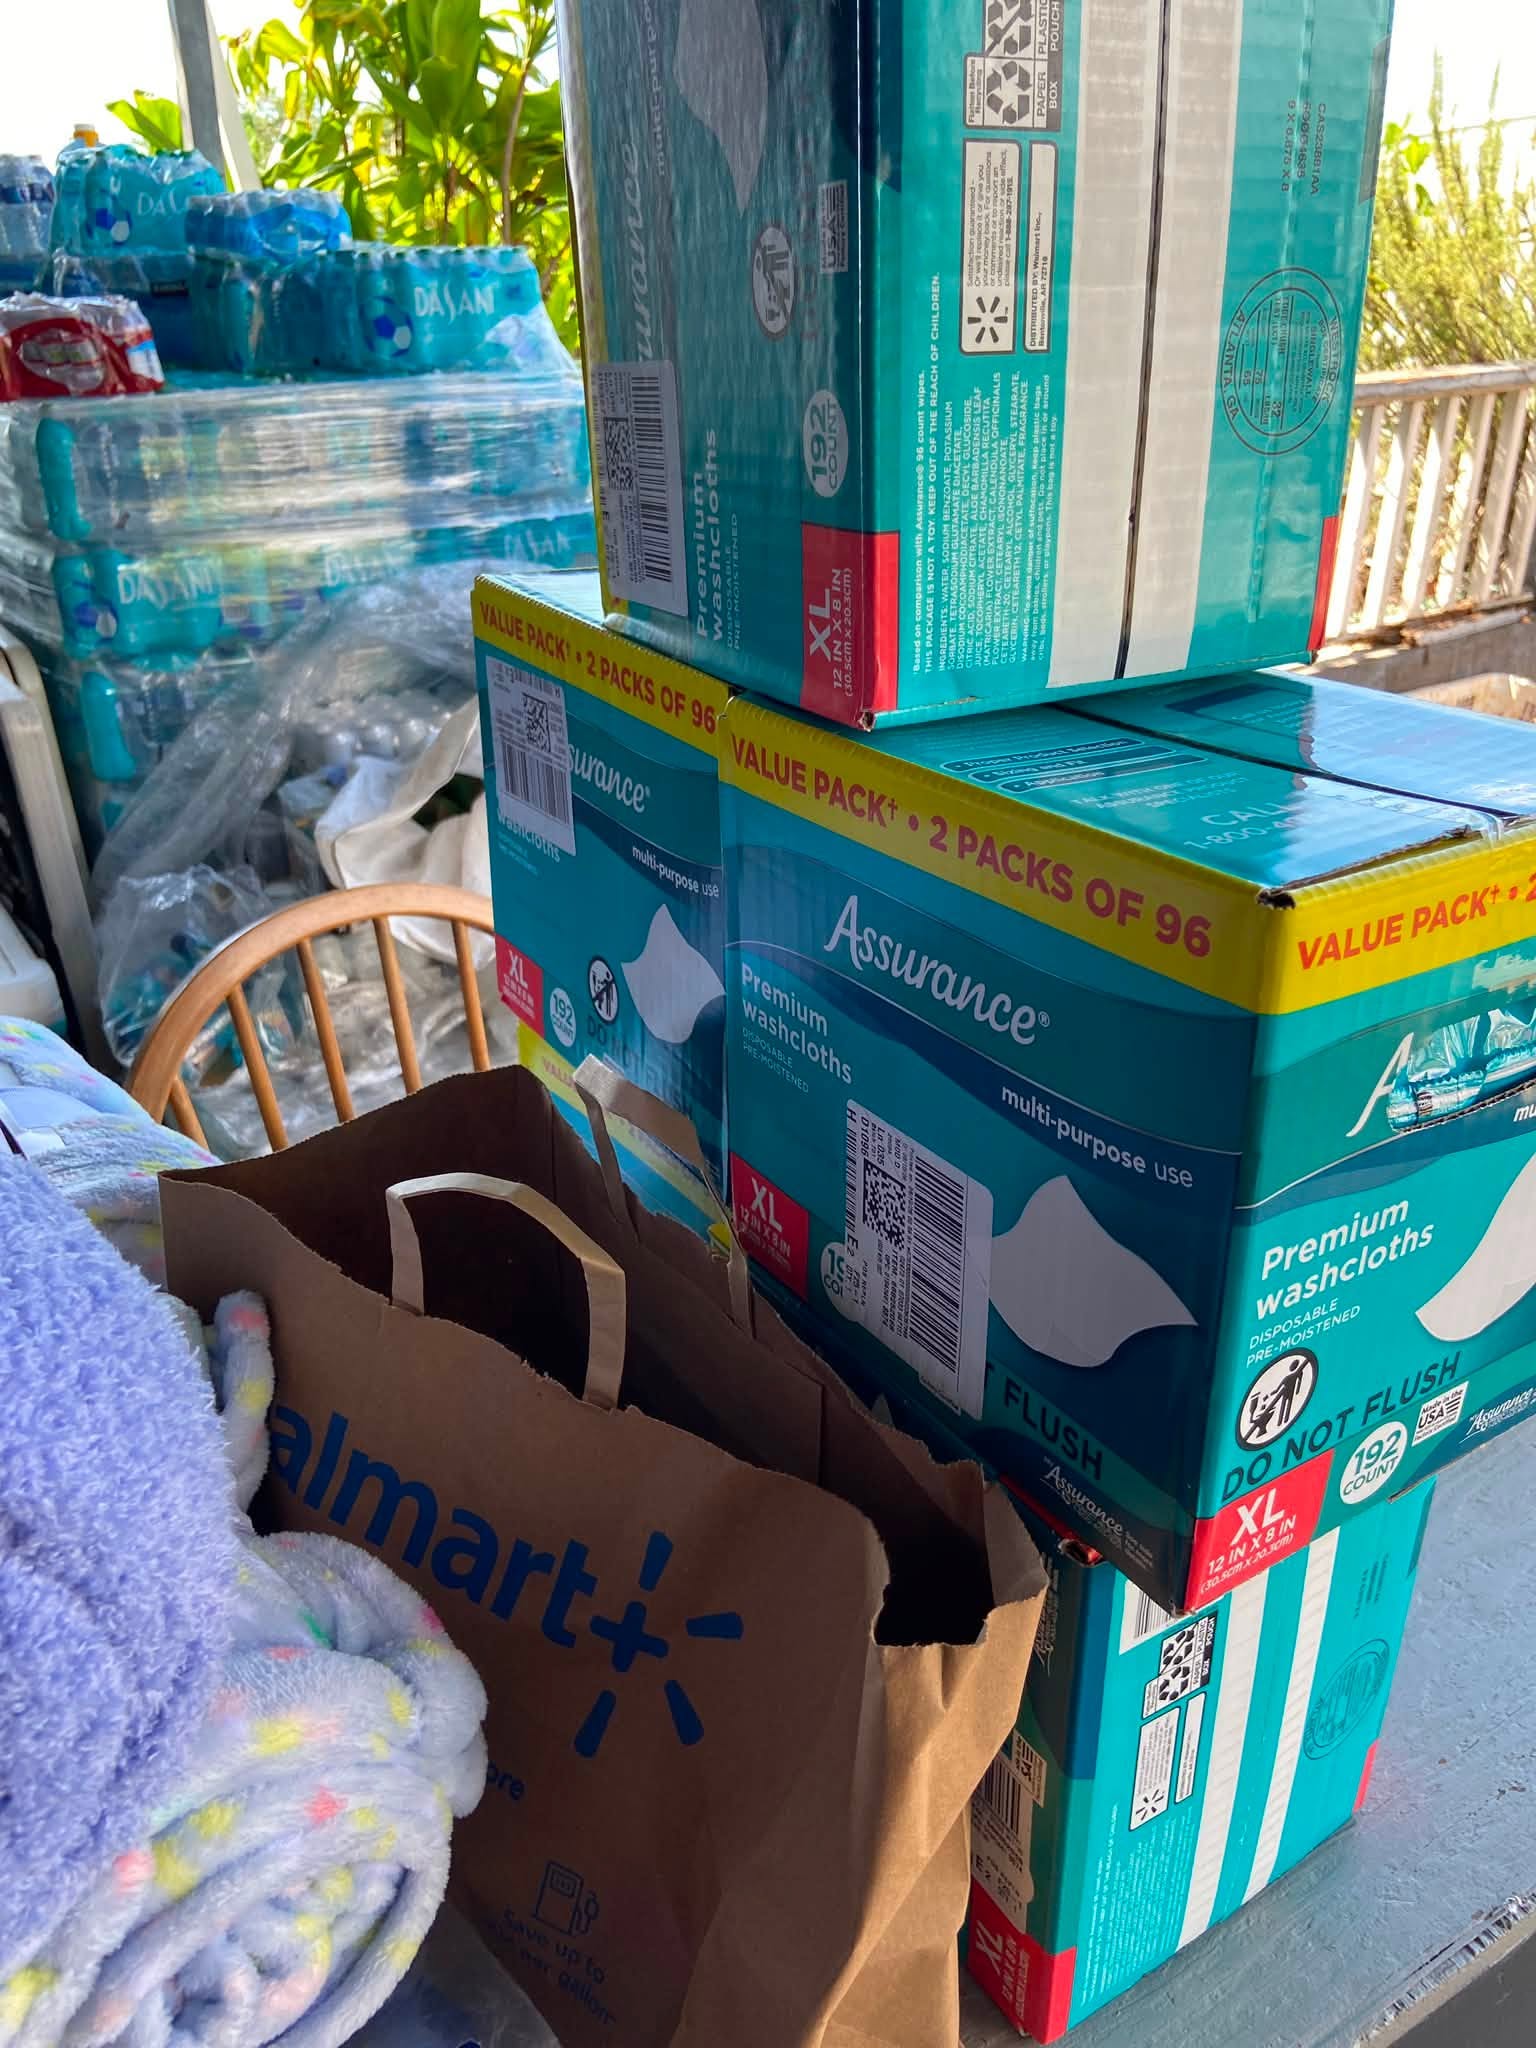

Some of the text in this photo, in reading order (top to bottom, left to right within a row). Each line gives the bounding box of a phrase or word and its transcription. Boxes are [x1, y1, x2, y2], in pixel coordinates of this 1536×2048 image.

[1050, 1, 1060, 52] POUCH
[1037, 71, 1046, 117] PAPER
[1049, 80, 1058, 109] BOX
[1032, 233, 1041, 269] Walmart
[931, 272, 940, 340] CHILDREN.
[1030, 288, 1038, 347] DISTRIBUTED
[1038, 284, 1047, 347] Bentonville, AR
[930, 344, 939, 361] OF
[930, 365, 938, 407] REACH
[991, 372, 1001, 439] OFFICINALIS
[1225, 396, 1240, 421] GA
[1272, 401, 1282, 417] 32
[809, 405, 828, 481] 192
[828, 398, 839, 490] COUNT
[916, 411, 925, 443] count
[929, 410, 937, 433] THE
[929, 438, 937, 454] OF
[943, 401, 952, 461] POTASSIUM
[916, 447, 924, 461] 96
[928, 486, 936, 515] KEEP
[693, 471, 708, 639] Premium
[704, 428, 723, 641] washcloths
[928, 546, 934, 554] A
[942, 524, 950, 562] SODIUM
[914, 559, 923, 621] comparison
[927, 584, 934, 593] IS
[808, 588, 831, 663] XL
[831, 567, 842, 689] 12 IN X 8 IN
[915, 624, 921, 637] on
[926, 597, 934, 647] PACKAGE
[480, 601, 525, 642] VALUE
[586, 650, 597, 678] 2
[600, 656, 656, 706] PACKS
[659, 685, 687, 720] OF
[691, 700, 717, 735] 96
[925, 650, 933, 672] THIS
[632, 845, 719, 898] multi-purpose use
[732, 733, 807, 794] VALUE
[929, 815, 948, 853] 2
[957, 824, 1073, 903] PACKS
[1085, 878, 1144, 926] OF
[1155, 903, 1211, 958] 96
[1297, 913, 1404, 971] VALUE
[509, 950, 528, 990] XL
[741, 961, 829, 1036] Premium
[742, 999, 852, 1085] washcloths
[742, 1026, 793, 1069] DISPOSABLE
[743, 1043, 810, 1093] PRE-MOISTENED
[847, 1108, 857, 1123] H
[1001, 1086, 1193, 1188] multi-purpose use
[752, 1177, 782, 1232] XL
[1261, 1199, 1409, 1281] Premium
[1256, 1224, 1434, 1321] washcloths
[1246, 1305, 1361, 1369] PRE-MOISTENED
[1249, 1297, 1339, 1350] DISPOSABLE
[1004, 1375, 1103, 1481] FLUSH
[1221, 1452, 1273, 1501] DO
[1281, 1406, 1354, 1469] NOT
[1361, 1351, 1462, 1427] FLUSH
[1418, 1405, 1444, 1429] USA
[1342, 1454, 1399, 1497] COUNT
[1352, 1430, 1402, 1475] 192
[1208, 1515, 1297, 1574] 12 IN X 8 IN
[1229, 1488, 1285, 1547] XL
[1199, 1561, 1244, 1595] (30.5cm
[1251, 1533, 1294, 1565] 20.3cm)
[975, 1920, 1002, 1976] XL
